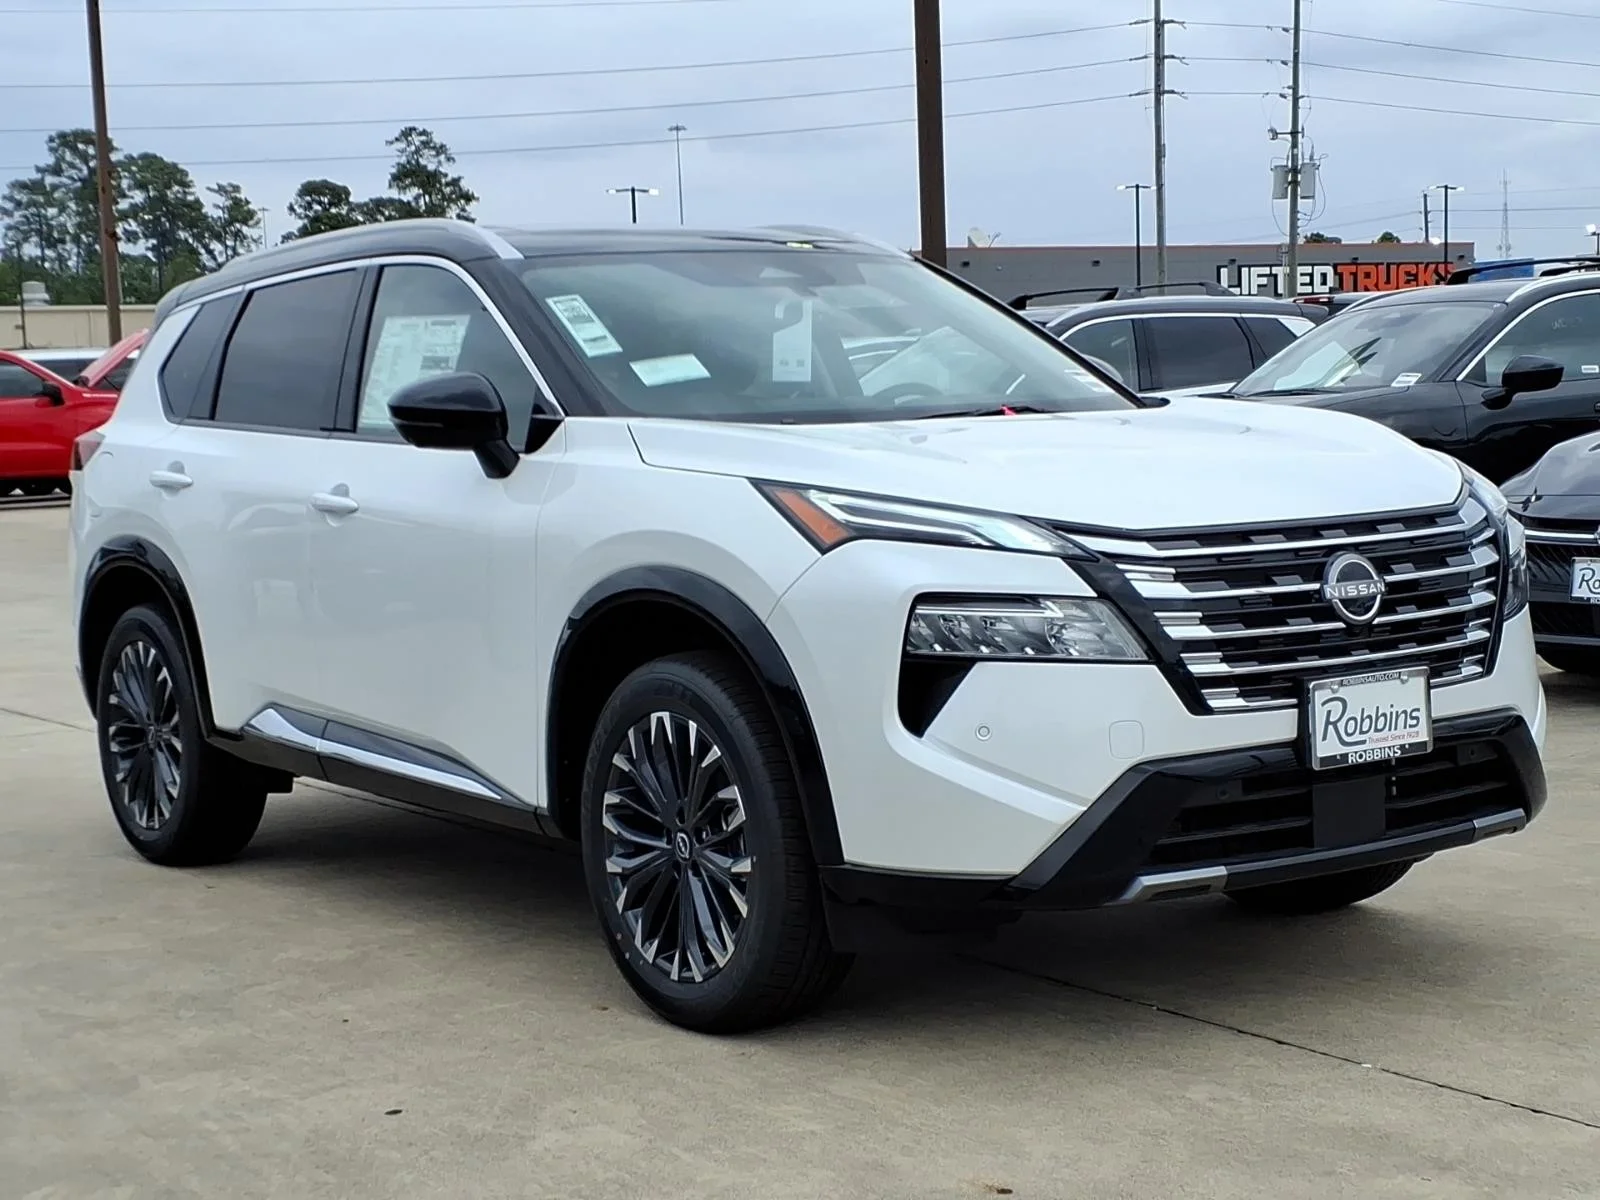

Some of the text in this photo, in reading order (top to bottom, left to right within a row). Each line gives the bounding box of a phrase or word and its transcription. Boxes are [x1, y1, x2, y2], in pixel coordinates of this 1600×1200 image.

[1220, 265, 1335, 295] LIFTED
[1327, 582, 1385, 597] NISSAN
[1321, 696, 1421, 748] Robbins
[1348, 745, 1402, 764] ROBBINS
